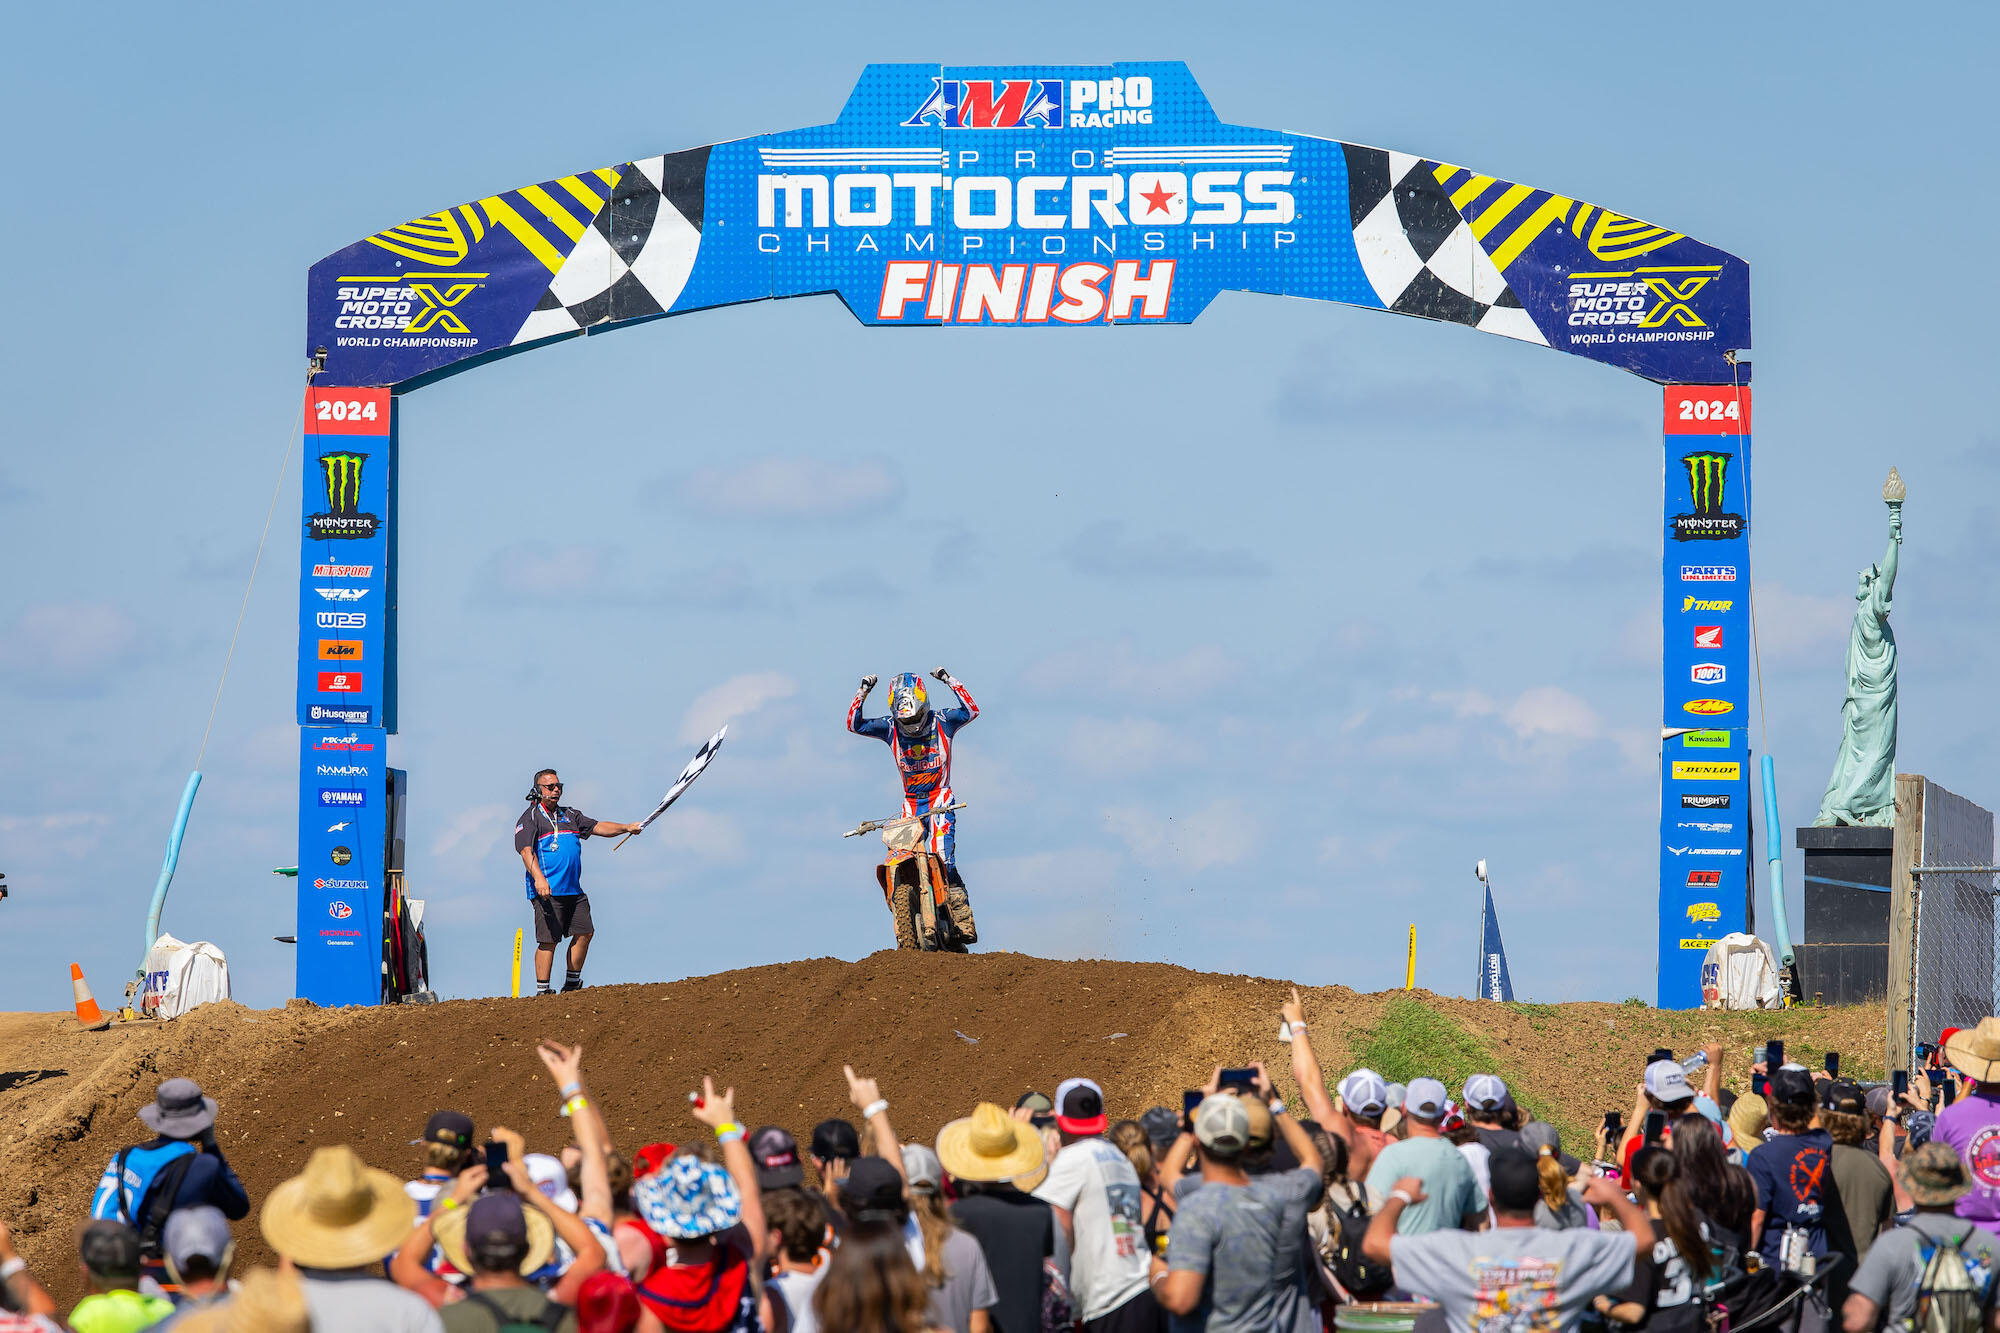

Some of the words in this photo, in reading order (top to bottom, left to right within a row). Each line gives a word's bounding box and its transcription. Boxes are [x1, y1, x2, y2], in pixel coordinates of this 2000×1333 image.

[1070, 76, 1153, 111] PRO
[900, 77, 1064, 129] AMA
[1070, 109, 1153, 129] RACING
[959, 150, 1095, 169] PRO
[758, 171, 1295, 229] MOTOCROSS
[758, 232, 1296, 256] CHAMPIONSHIP
[336, 287, 417, 301] SUPER
[878, 260, 1177, 323] FINISH
[1568, 282, 1649, 297] SUPER
[340, 301, 411, 315] MOTO
[1574, 297, 1645, 311] MOTO
[335, 316, 412, 329] CROSS
[1568, 311, 1646, 326] CROSS
[336, 337, 381, 347] WORLD
[383, 337, 479, 348] CHAMPIONSHIP
[1570, 334, 1616, 344] WORLD
[1618, 331, 1715, 343] CHAMPIONSHIP
[318, 401, 377, 421] 2024
[1679, 400, 1739, 420] 2024
[313, 517, 372, 528] MONSTER
[1677, 518, 1738, 529] MONSTER
[1682, 567, 1735, 575] PARTS
[314, 588, 370, 599] FLY
[1694, 600, 1733, 610] THOR
[317, 612, 366, 628] WPS
[326, 645, 355, 655] KTM
[1696, 668, 1721, 679] 100%
[322, 709, 367, 719] Husqvarna
[317, 764, 368, 774] NAMURA
[900, 761, 919, 772] Red
[920, 757, 942, 771] Bull
[331, 792, 363, 801] YAMAHA
[1682, 796, 1720, 805] TRIUMPH
[891, 825, 914, 846] 4
[1688, 871, 1721, 882] ETS
[326, 879, 368, 889] SUZUKI
[1686, 902, 1718, 918] MOTO
[1691, 910, 1721, 924] TEES
